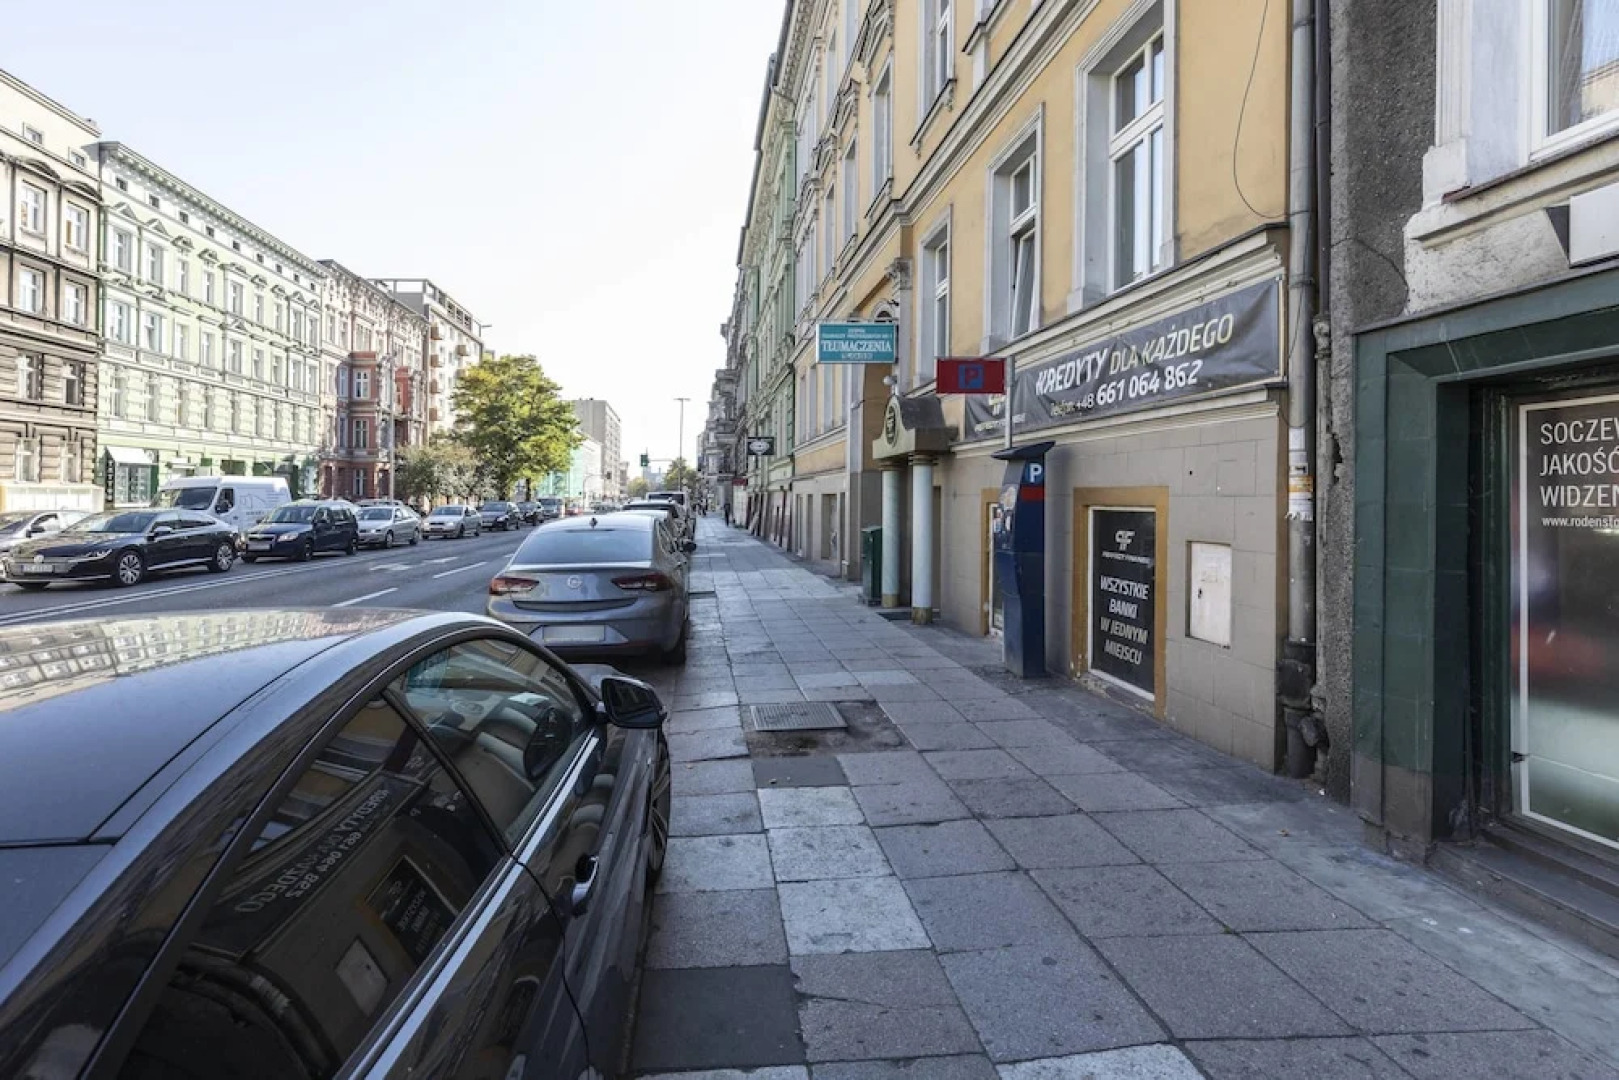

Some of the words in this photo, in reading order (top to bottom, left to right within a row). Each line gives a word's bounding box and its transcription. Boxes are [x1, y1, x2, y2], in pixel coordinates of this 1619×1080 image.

[1036, 347, 1108, 396] KREDYTY
[1109, 345, 1138, 376] DLA
[1141, 313, 1234, 365] KAŻDEGO
[1096, 378, 1125, 406] 661
[1129, 370, 1160, 399] 064
[1164, 359, 1204, 391] 862
[1540, 416, 1619, 445] SOCZE
[1029, 462, 1042, 483] P
[1100, 574, 1150, 600] WSZYSTKIE
[1108, 598, 1139, 619] BANKI
[1100, 616, 1109, 632] W
[1110, 620, 1149, 645] JEDNYM
[1104, 638, 1143, 665] MIEJSCU
